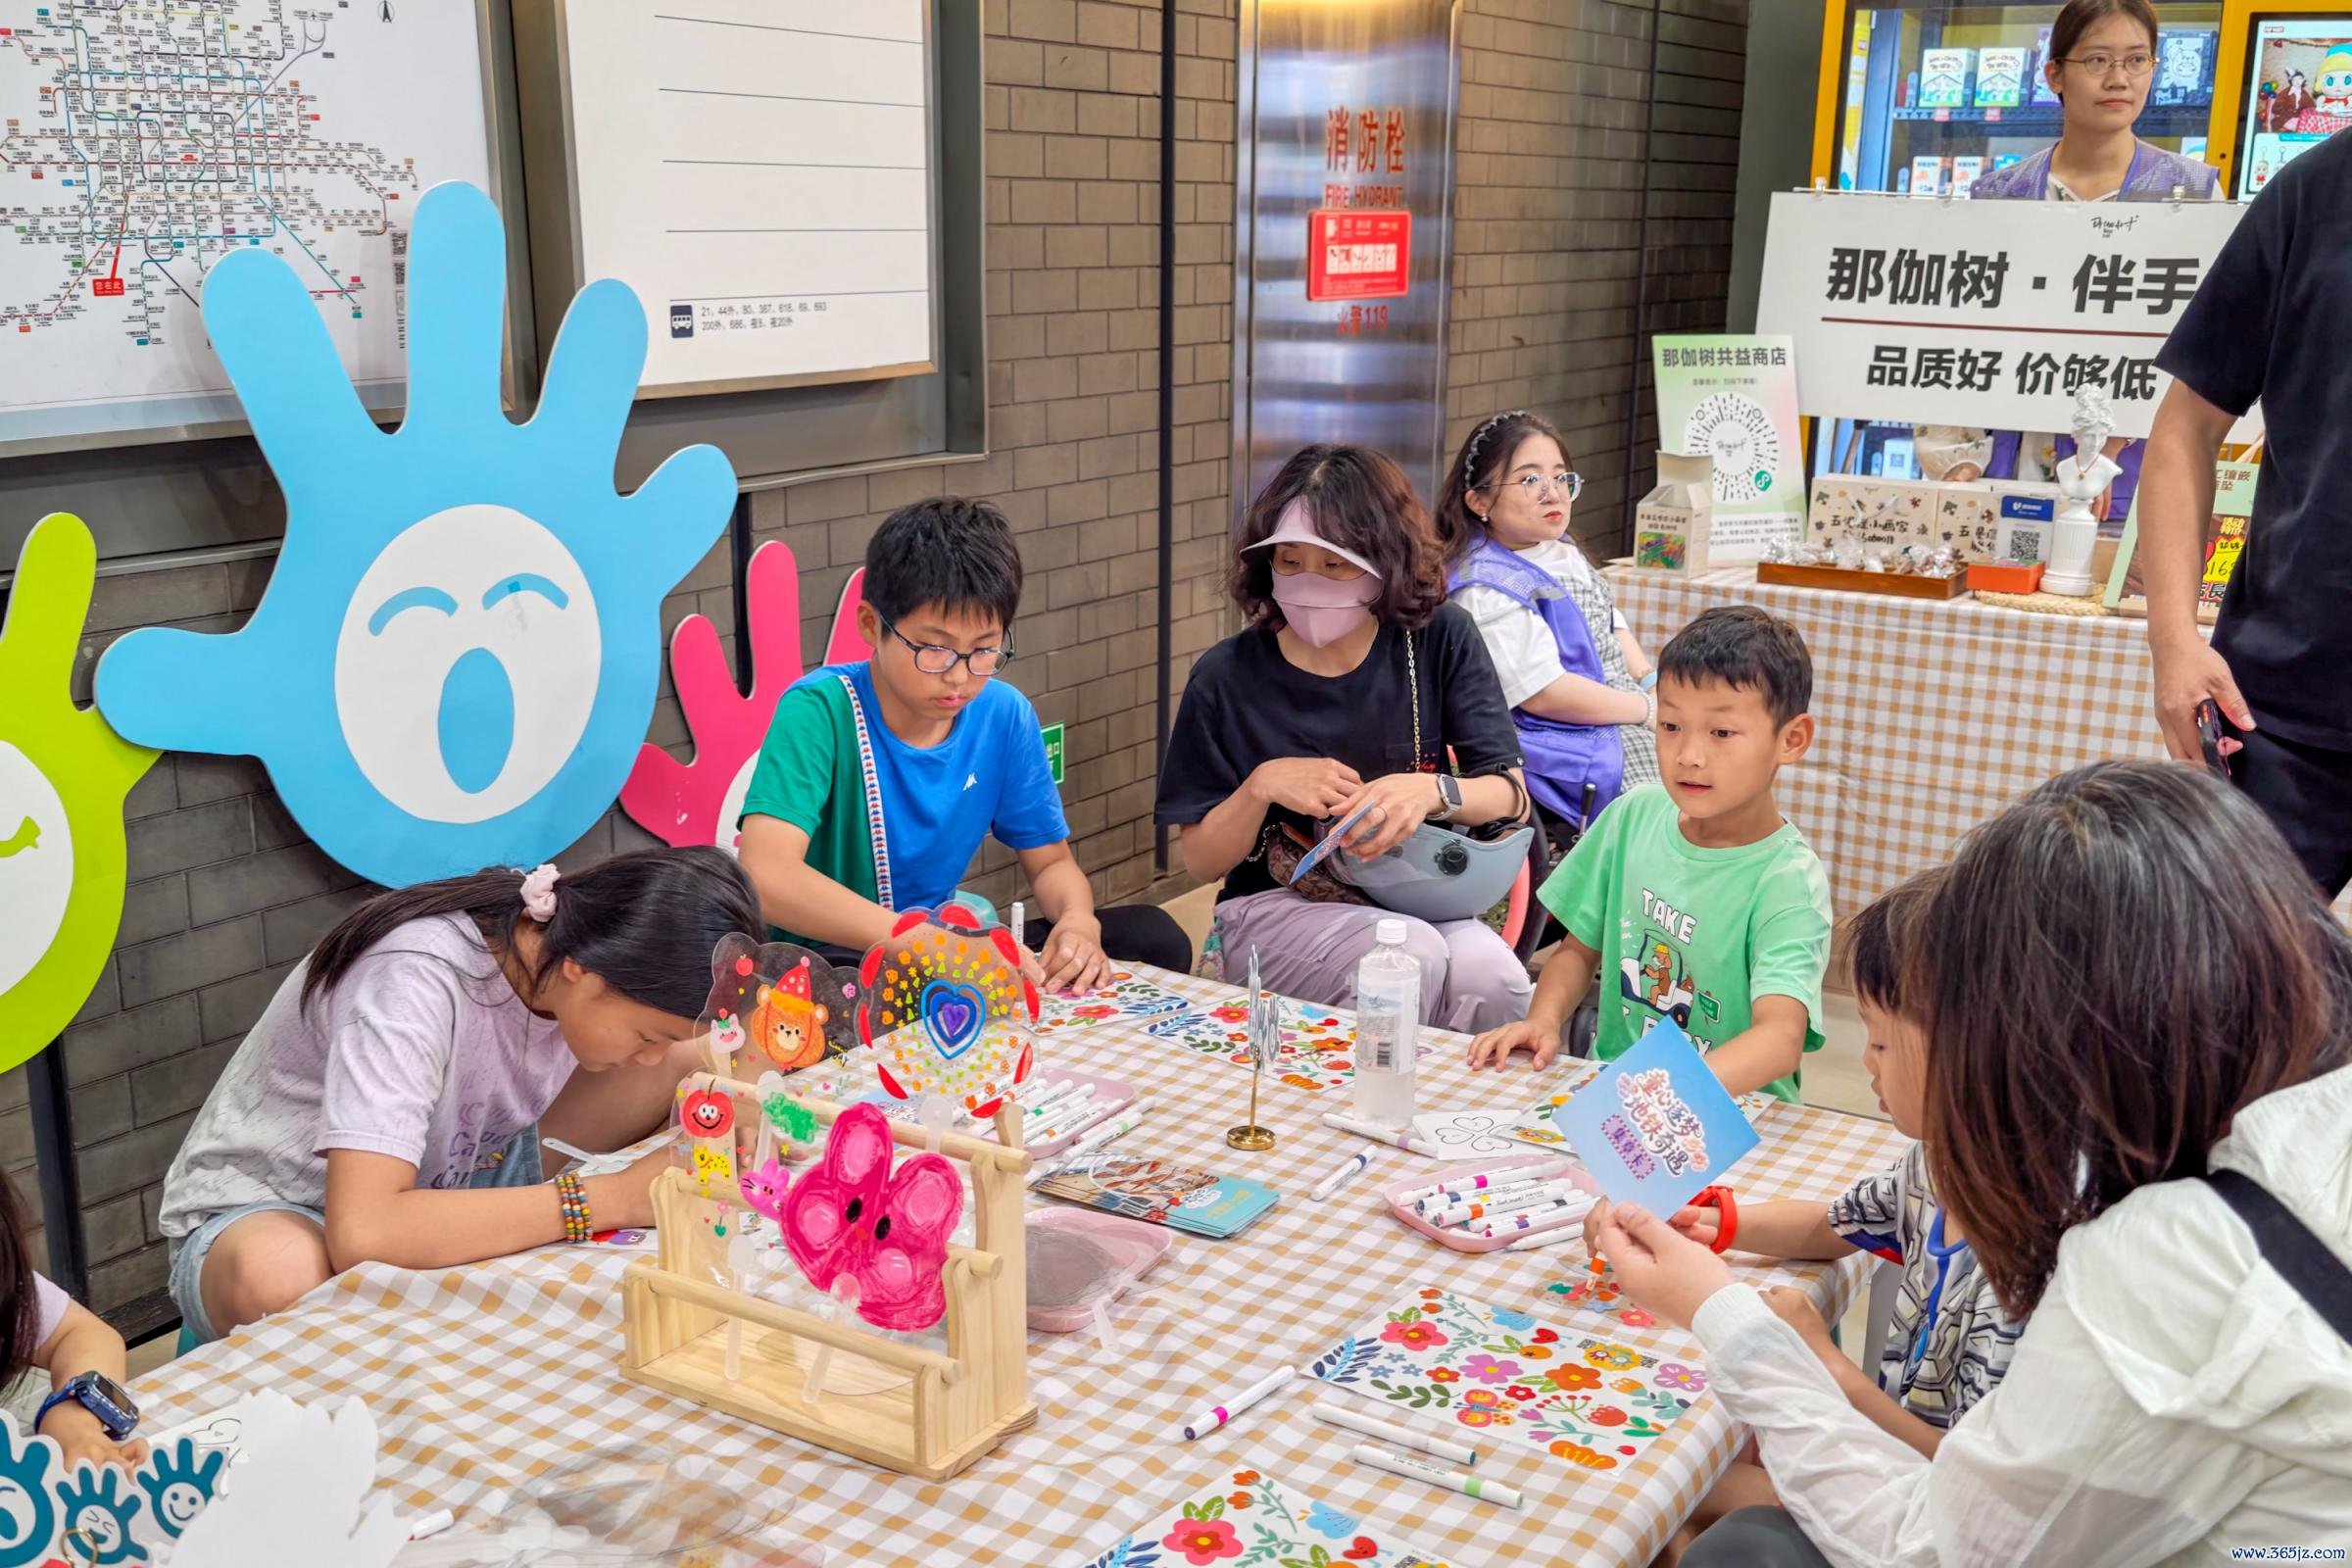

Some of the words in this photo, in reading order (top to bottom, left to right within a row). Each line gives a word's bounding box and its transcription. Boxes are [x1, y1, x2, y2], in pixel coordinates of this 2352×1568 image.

[1326, 106, 1405, 173] 消防栓
[1325, 183, 1348, 208] FIRE
[1355, 185, 1402, 208] HYDRANT
[1337, 305, 1389, 333] 火警119
[1662, 347, 1787, 368] 那伽树共益商店
[1866, 344, 2003, 392] 品质好
[2015, 351, 2157, 401] 价够低
[1641, 887, 1698, 946] TAKE
[1636, 1070, 1703, 1139] 童心逐梦
[1613, 1127, 1645, 1167] 集章卡
[1624, 1097, 1690, 1176] 地铁奇遇
